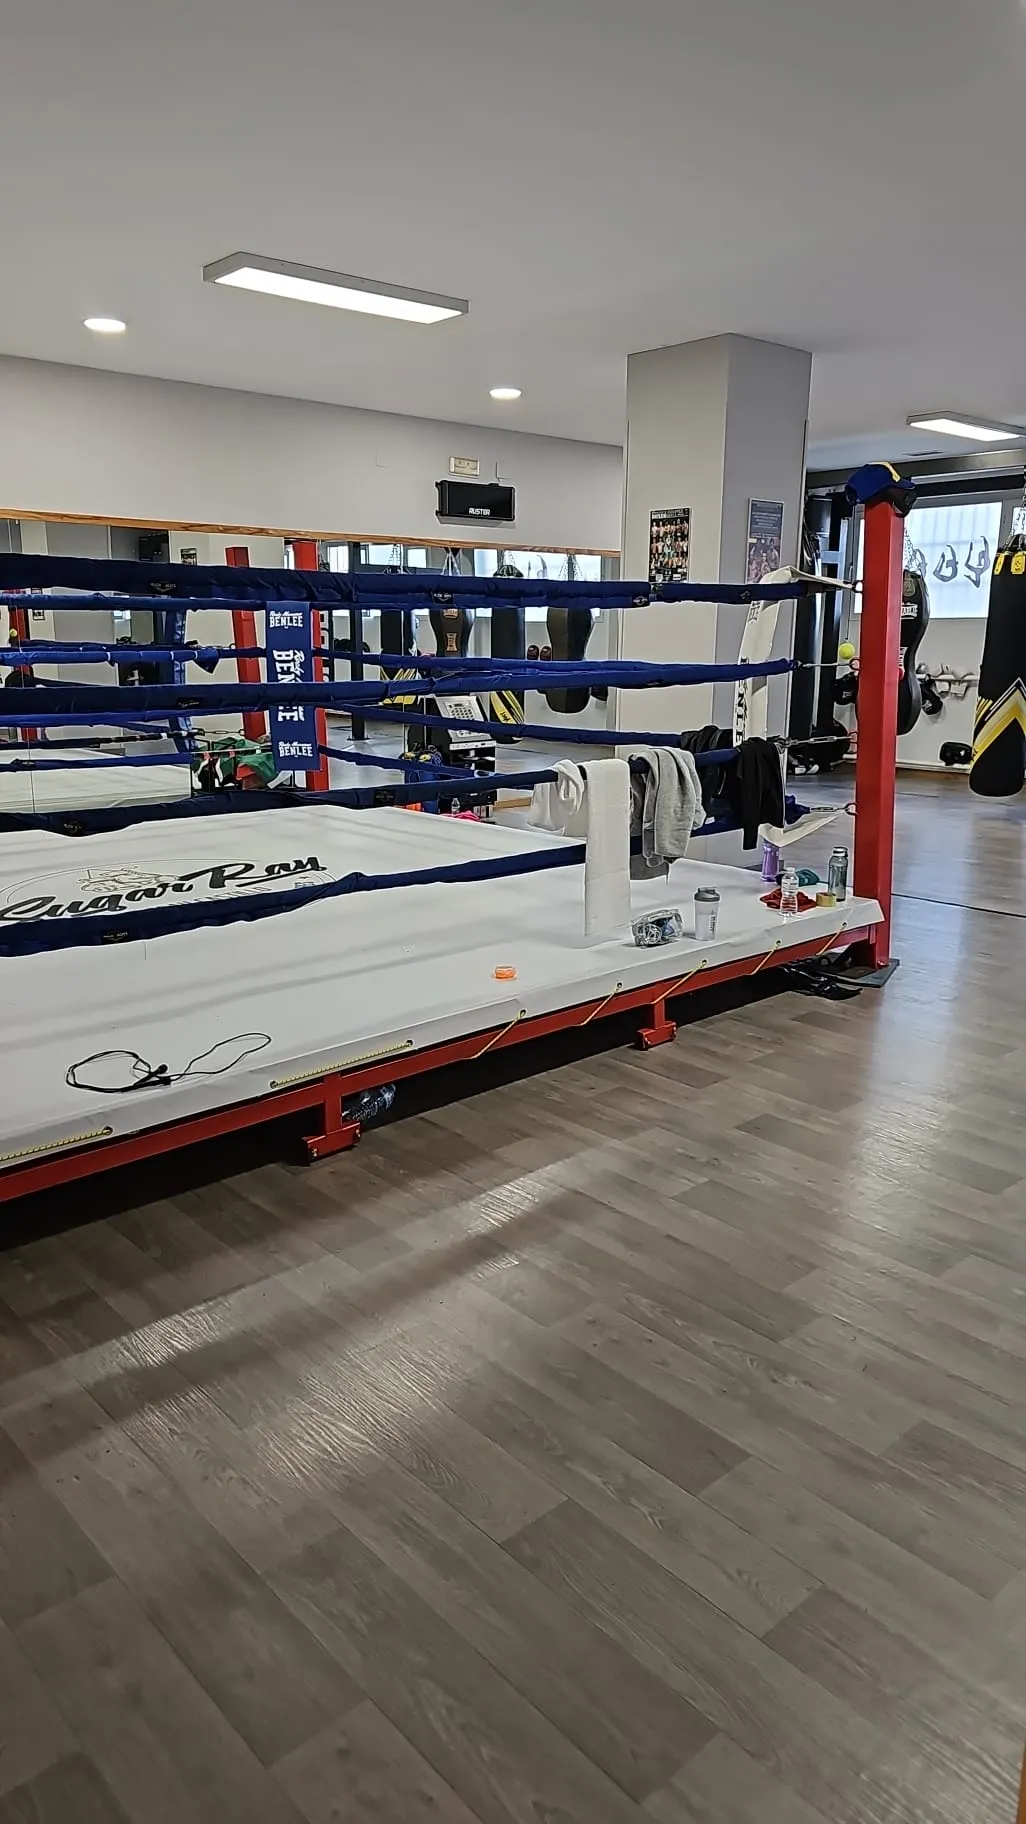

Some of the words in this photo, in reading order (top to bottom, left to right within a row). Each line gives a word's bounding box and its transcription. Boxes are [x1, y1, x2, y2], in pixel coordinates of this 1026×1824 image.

[269, 615, 304, 628] BENLEE
[272, 649, 300, 722] BENE
[279, 745, 313, 758] BENLEE
[178, 856, 328, 889] Ray
